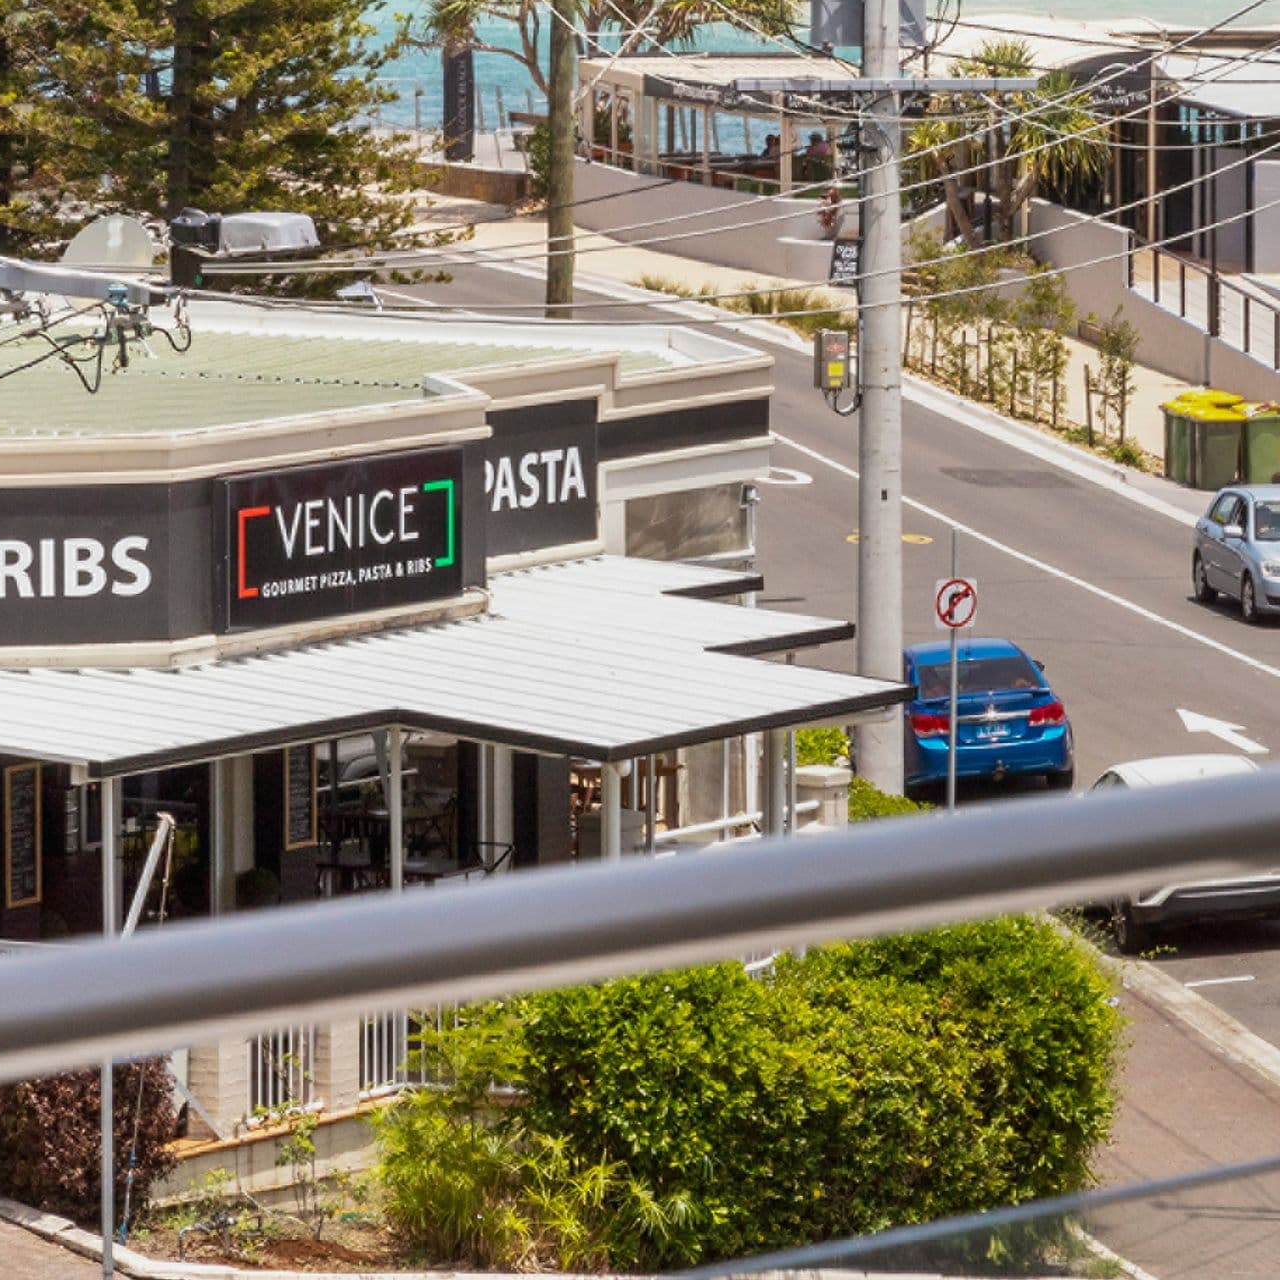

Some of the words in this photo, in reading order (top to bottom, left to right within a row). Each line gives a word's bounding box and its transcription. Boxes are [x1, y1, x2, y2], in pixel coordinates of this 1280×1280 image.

[274, 485, 420, 560] VENICE
[262, 575, 319, 599] GOURMET
[319, 570, 357, 590] PIZZA,
[358, 563, 394, 585] PASTA
[395, 560, 406, 577] &
[406, 556, 433, 575] RIBS
